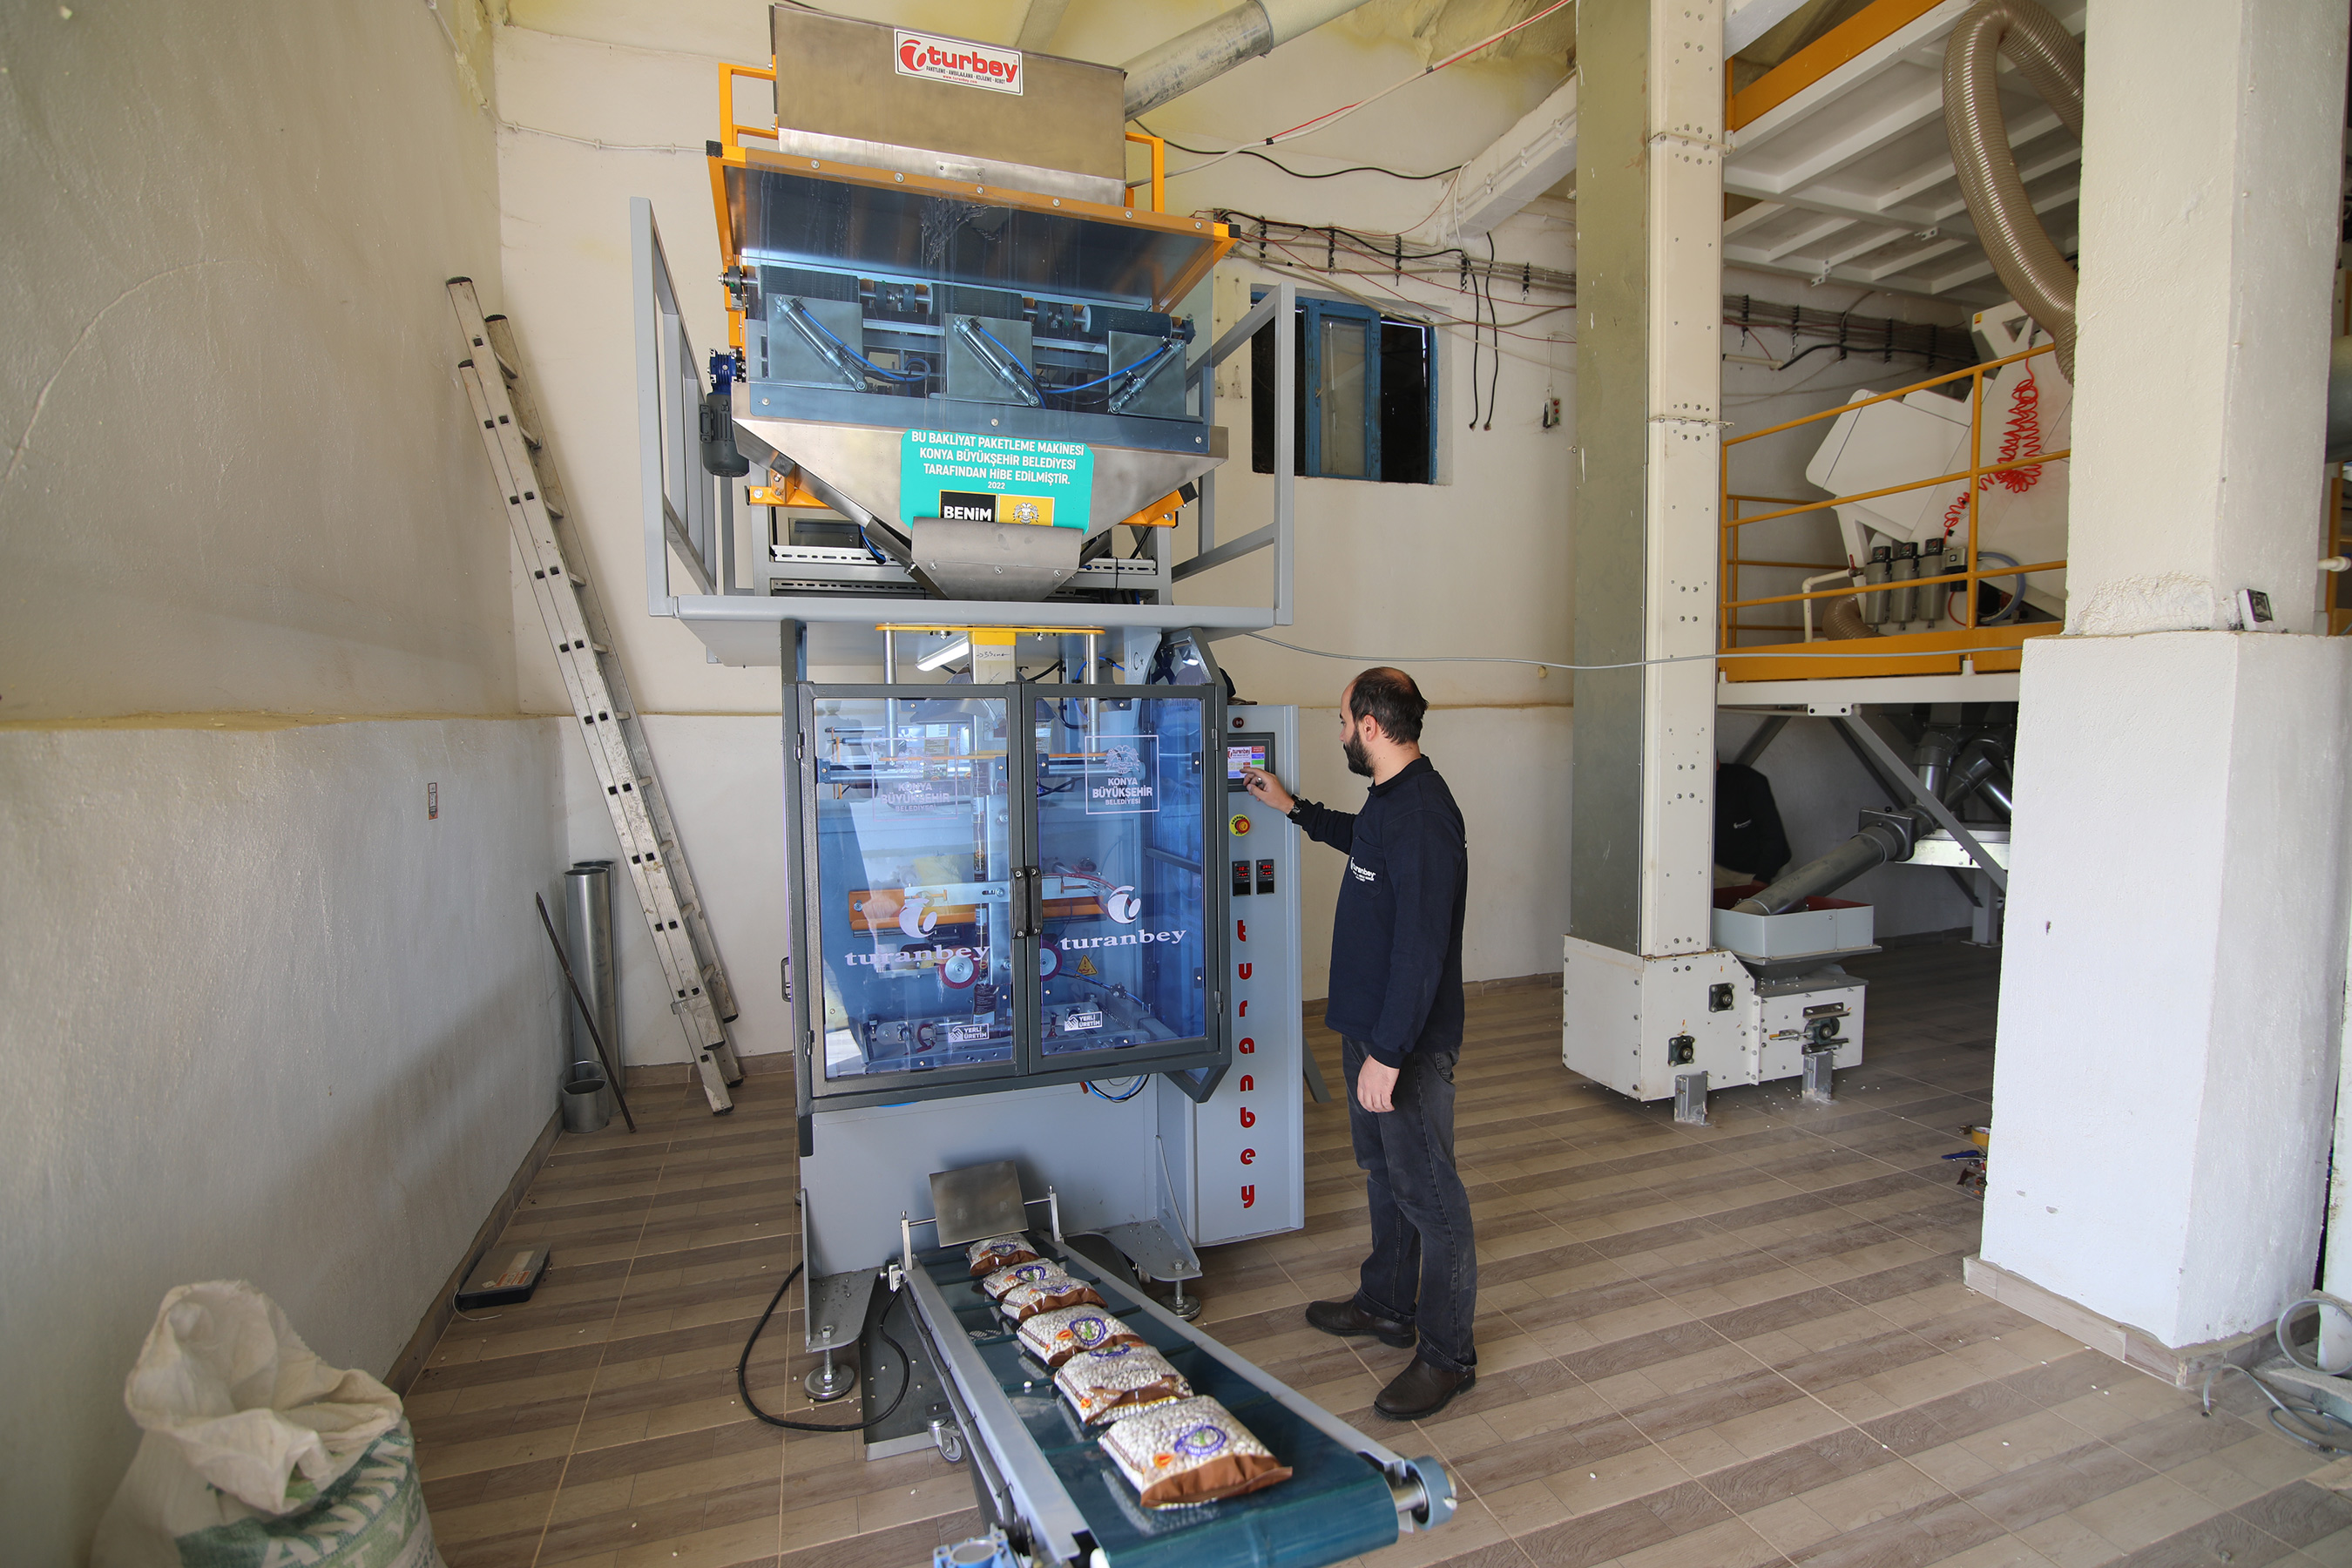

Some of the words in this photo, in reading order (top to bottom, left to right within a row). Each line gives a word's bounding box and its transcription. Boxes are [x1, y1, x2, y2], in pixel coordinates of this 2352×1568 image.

[927, 45, 1017, 83] turbey
[911, 430, 926, 443] BU
[929, 432, 976, 447] BAKLİYAT
[977, 436, 1035, 452] PAKETLEME
[1037, 442, 1085, 456] MAKİNESİ
[919, 447, 954, 461] KONYA
[956, 449, 1020, 466] BÜYÜKŞEHİR
[1022, 454, 1076, 470] BELEDİYESİ
[923, 463, 987, 478] TARAFINDAN
[989, 470, 1013, 481] HİBE
[943, 505, 992, 522] BENİM
[898, 782, 933, 792] KONYA
[1107, 777, 1139, 786] KONYA
[880, 791, 950, 804] BÜYÜKŞEHİR
[1092, 785, 1153, 799] BÜYÜKŞEHİR
[1059, 929, 1187, 951] turanbey
[844, 944, 990, 967] turanbey
[1236, 919, 1256, 1209] turanbey
